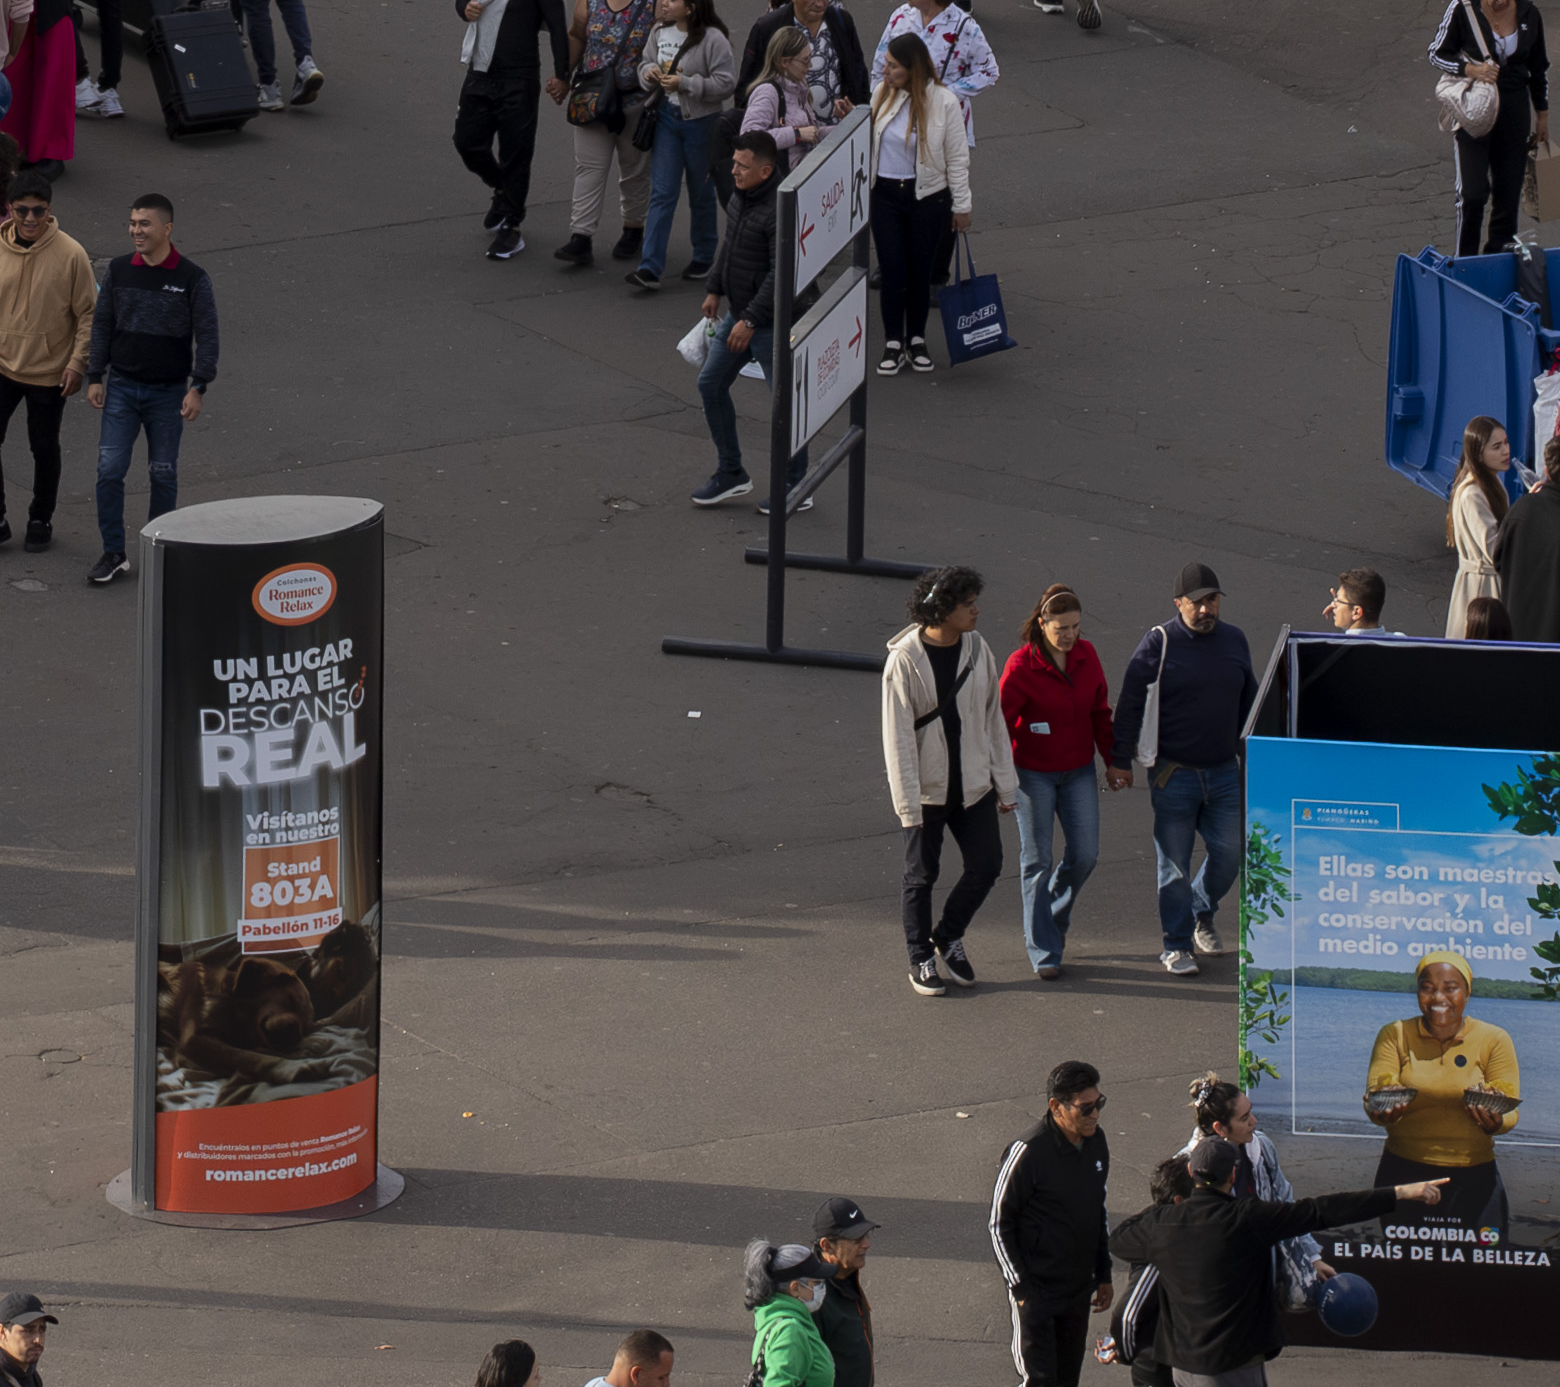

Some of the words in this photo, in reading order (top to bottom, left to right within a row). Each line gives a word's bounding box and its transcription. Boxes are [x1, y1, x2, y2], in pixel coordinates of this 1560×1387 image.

[821, 178, 845, 217] SALIDA
[269, 585, 323, 601] Romance
[277, 576, 317, 586] Colchones
[281, 600, 313, 613] Relax
[214, 657, 258, 681] UN
[267, 638, 353, 677] LUGAR
[229, 675, 311, 704] PARA
[317, 665, 345, 691] EL
[200, 683, 364, 735] DESCANSO
[201, 711, 366, 787] REAL
[246, 807, 338, 830] Visítanos
[246, 832, 270, 844] en
[276, 822, 339, 843] nuestro
[267, 856, 320, 877] Stand
[1319, 855, 1375, 878] Ellas
[1384, 863, 1428, 880] son
[1439, 865, 1554, 886] maestras
[250, 875, 334, 908] 803A
[1319, 881, 1357, 903] del
[1369, 884, 1444, 906] sabor
[1454, 893, 1470, 913] y
[1481, 887, 1504, 909] la
[242, 921, 309, 936] Pabellón
[313, 914, 339, 930] 11-16
[1319, 911, 1483, 934] conservación
[1493, 914, 1531, 936] del
[1319, 934, 1398, 955] medio
[1407, 936, 1527, 961] ambiente
[184, 1151, 236, 1160] distribuidores
[238, 1151, 275, 1160] marcados
[199, 1143, 249, 1152] Encuéntralos
[263, 1142, 288, 1151] puntos
[205, 1152, 357, 1181] romancerelax.com
[1385, 1225, 1477, 1242] COLOMBIA
[1480, 1230, 1499, 1242] CO
[1334, 1242, 1353, 1257] EL
[1360, 1240, 1403, 1260] PAÍS
[1411, 1246, 1434, 1261] DE
[1441, 1247, 1465, 1262] LA
[1473, 1249, 1551, 1267] BELLEZA
